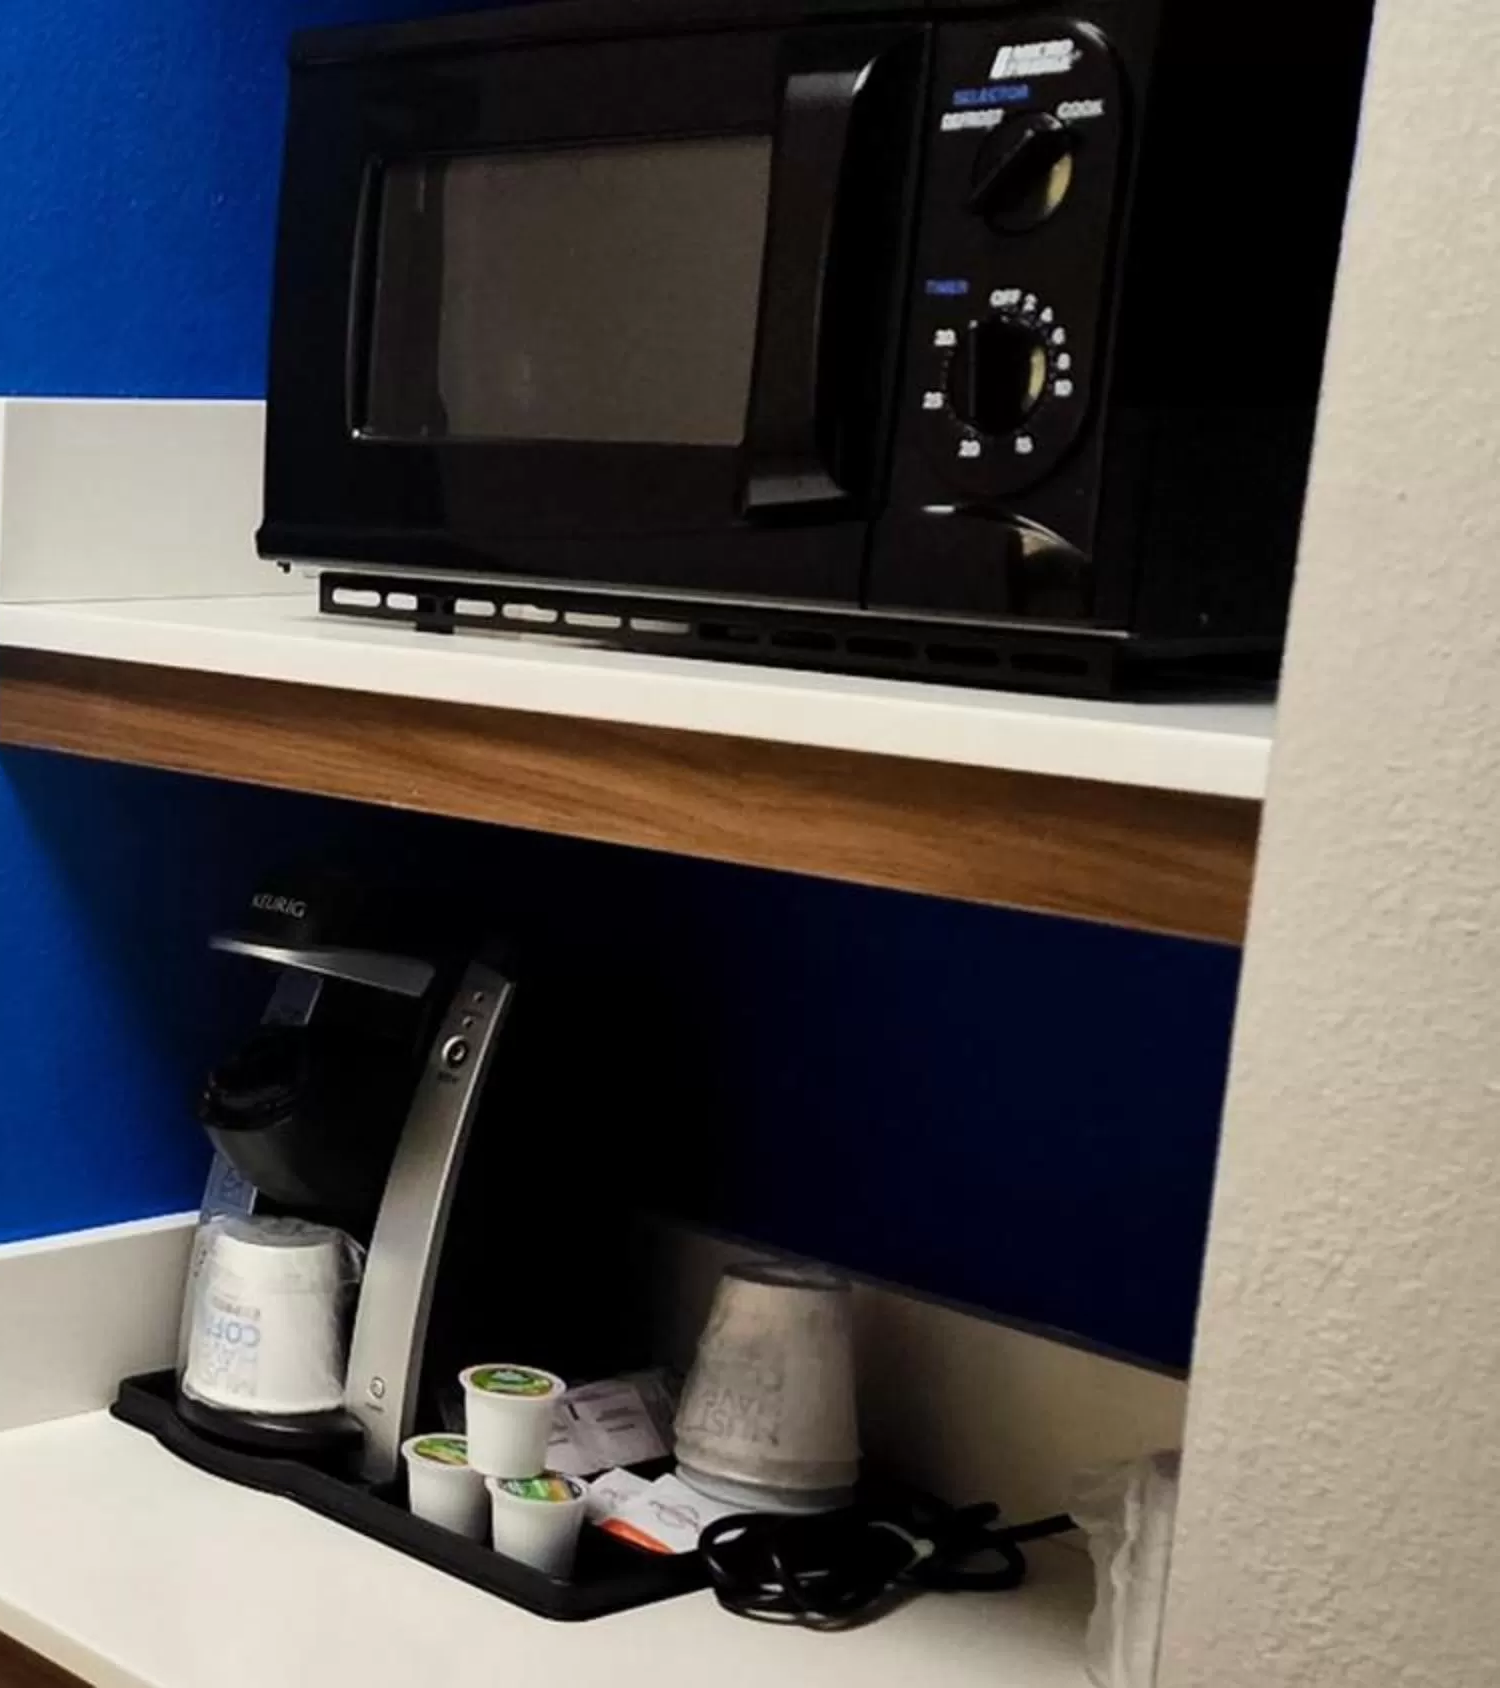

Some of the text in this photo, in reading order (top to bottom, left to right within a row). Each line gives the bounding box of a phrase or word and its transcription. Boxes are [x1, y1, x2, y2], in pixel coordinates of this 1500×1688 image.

[953, 84, 1029, 106] SELECTOR
[1056, 99, 1104, 119] COOK
[940, 109, 1004, 131] DEFROST
[925, 279, 968, 295] TIMER
[990, 288, 1022, 308] OFF
[1022, 293, 1037, 312] 2
[1040, 306, 1054, 323] 4
[1054, 378, 1073, 397] 10
[922, 391, 945, 410] 25
[958, 439, 981, 458] 20
[251, 892, 308, 919] KEURIG
